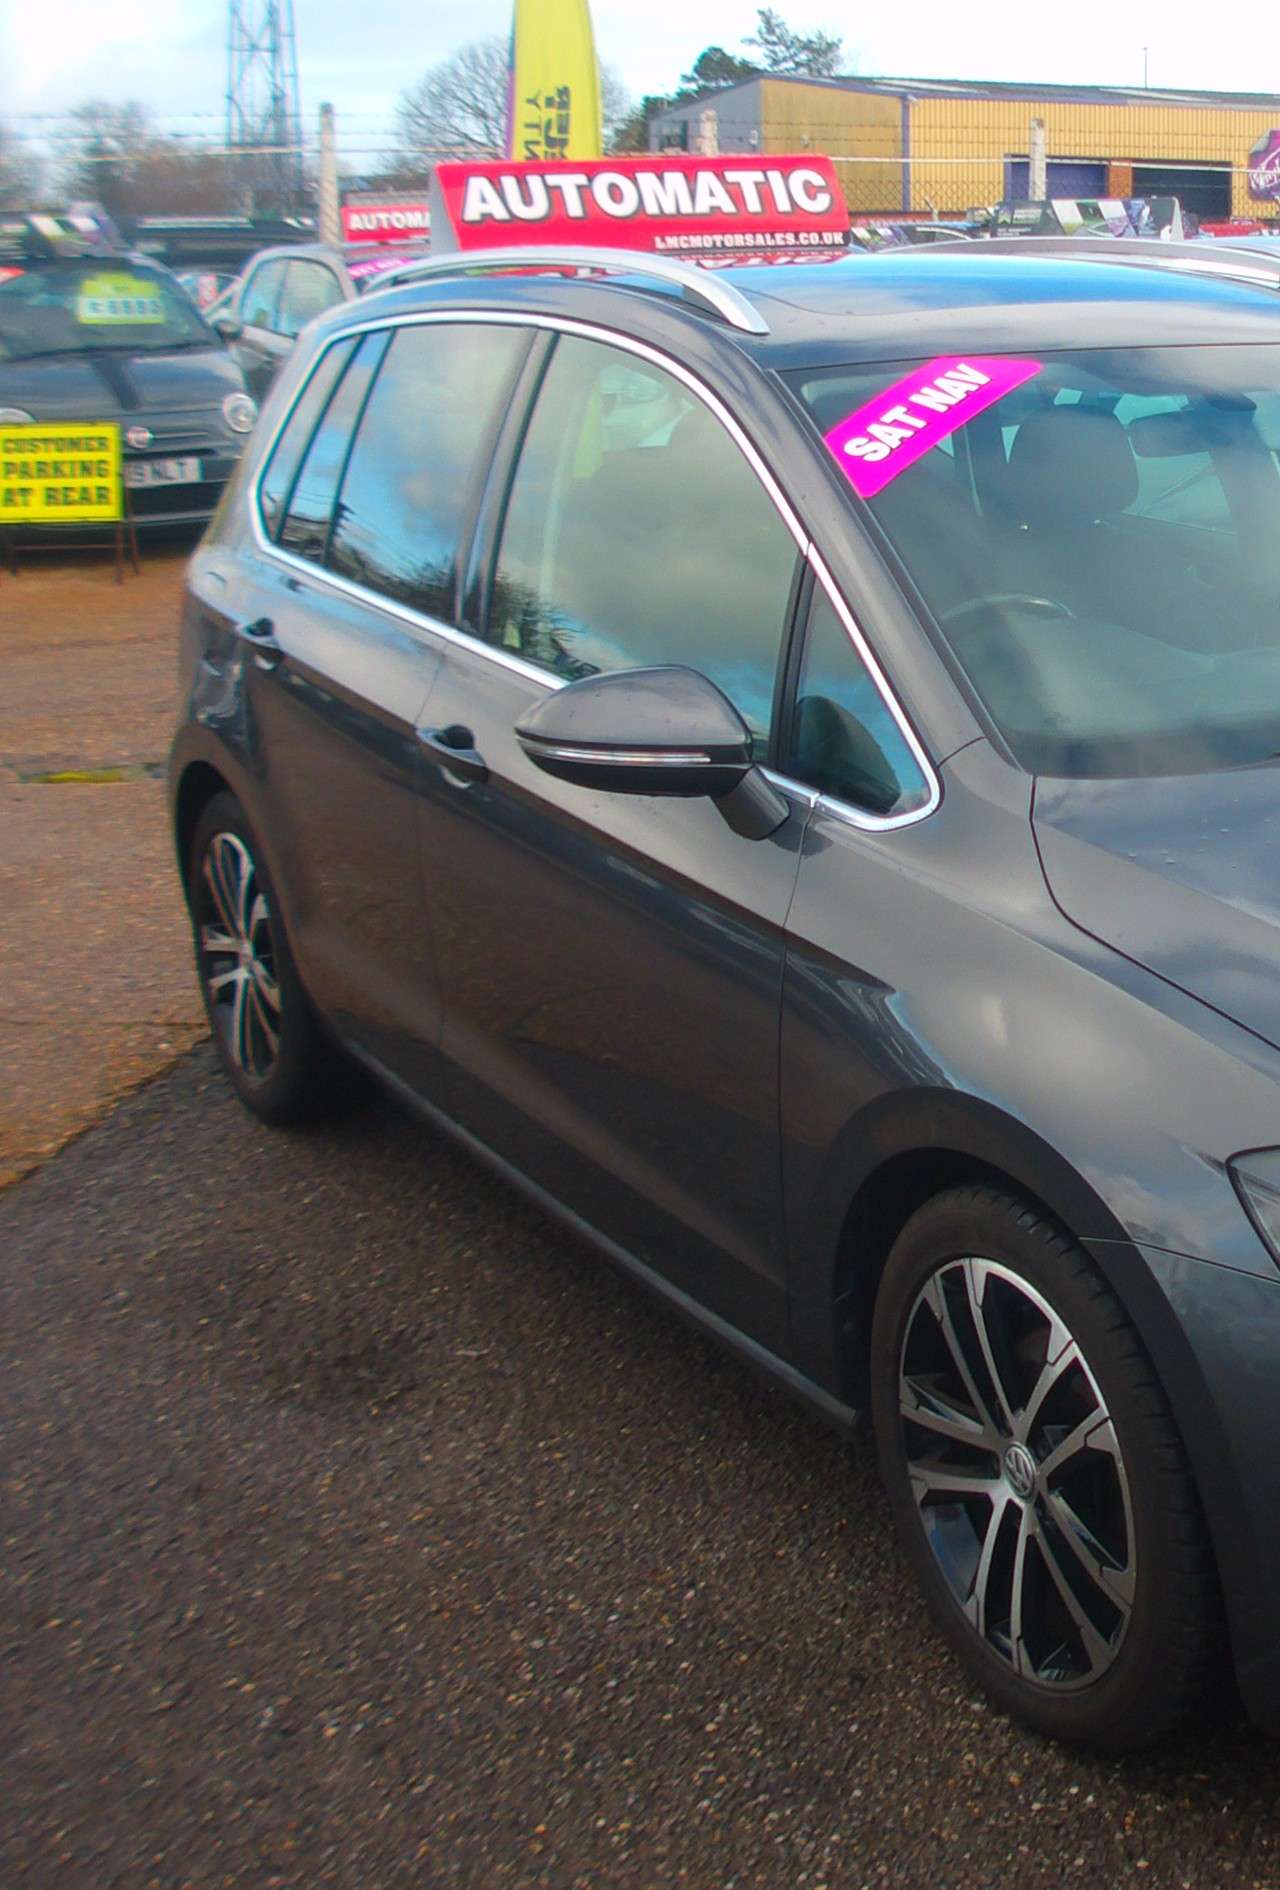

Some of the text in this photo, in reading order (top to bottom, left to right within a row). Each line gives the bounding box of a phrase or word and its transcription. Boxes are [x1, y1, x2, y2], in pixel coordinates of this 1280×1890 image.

[462, 169, 833, 222] AUTOMATIC
[654, 231, 845, 250] LMCMOTORSALES.CO.UK
[843, 363, 991, 462] SAT NAV
[2, 436, 110, 453] CUSTOMER
[2, 460, 109, 479] PARKING
[2, 486, 110, 506] AT REAR
